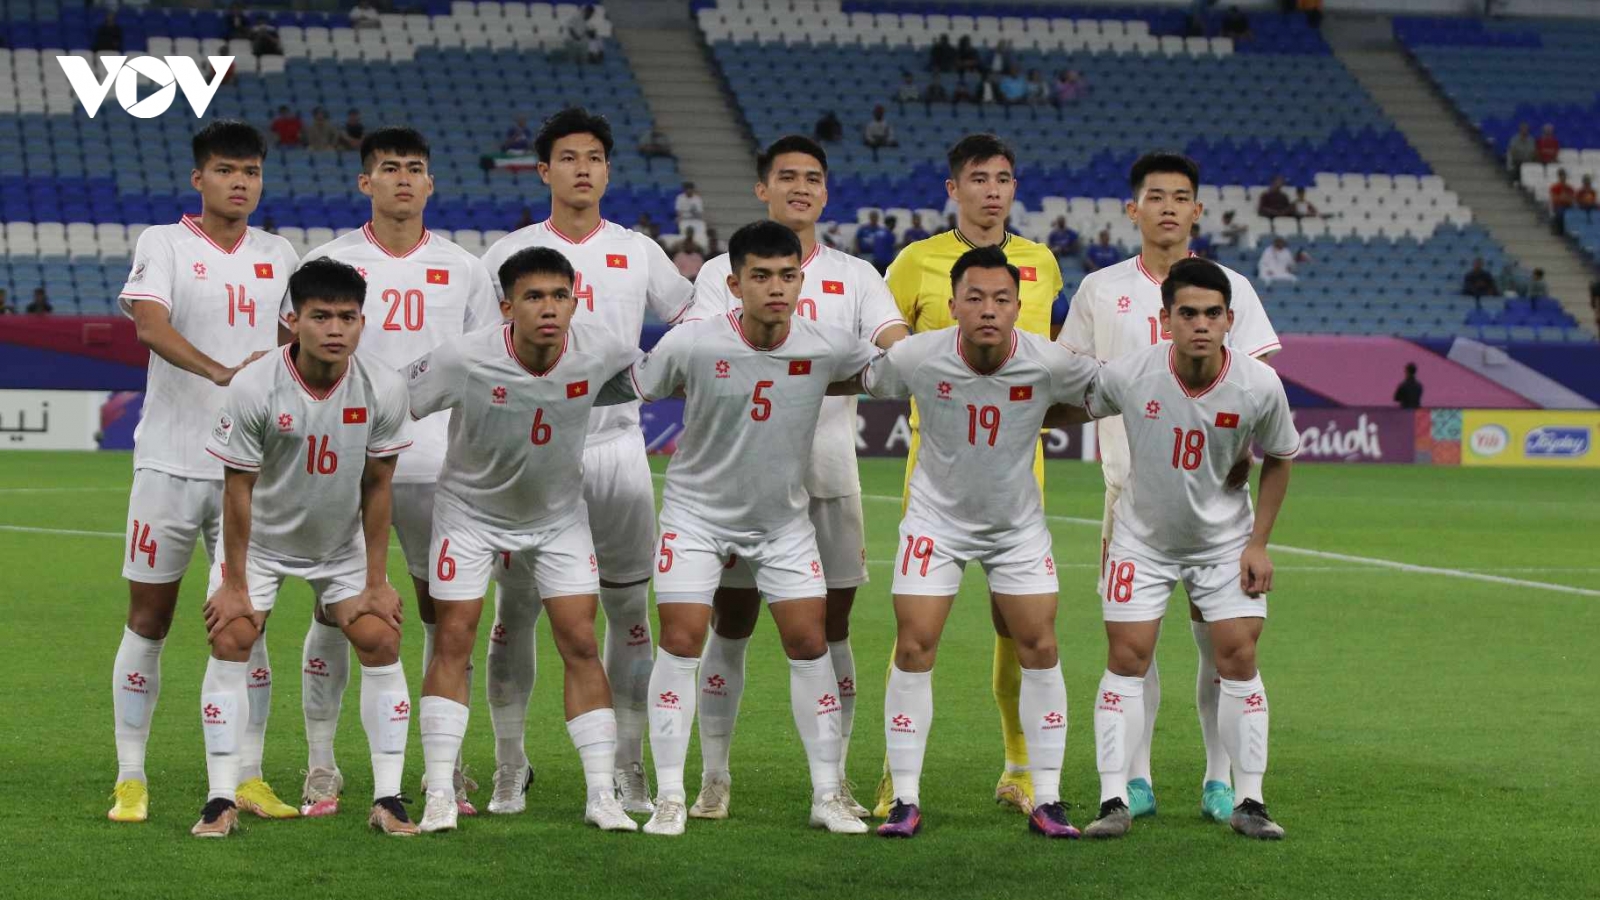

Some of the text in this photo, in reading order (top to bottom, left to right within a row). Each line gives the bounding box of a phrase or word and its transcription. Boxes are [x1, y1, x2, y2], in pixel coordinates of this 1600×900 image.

[225, 283, 255, 327] 14
[382, 289, 424, 331] 20
[751, 381, 774, 421] 5
[531, 408, 552, 445] 6
[967, 405, 1000, 446] 19
[306, 434, 338, 475] 16
[1172, 427, 1204, 470] 18
[131, 519, 157, 568] 14
[437, 538, 456, 581] 6
[658, 533, 677, 573] 5
[901, 535, 934, 577] 19
[1107, 560, 1136, 603] 18
